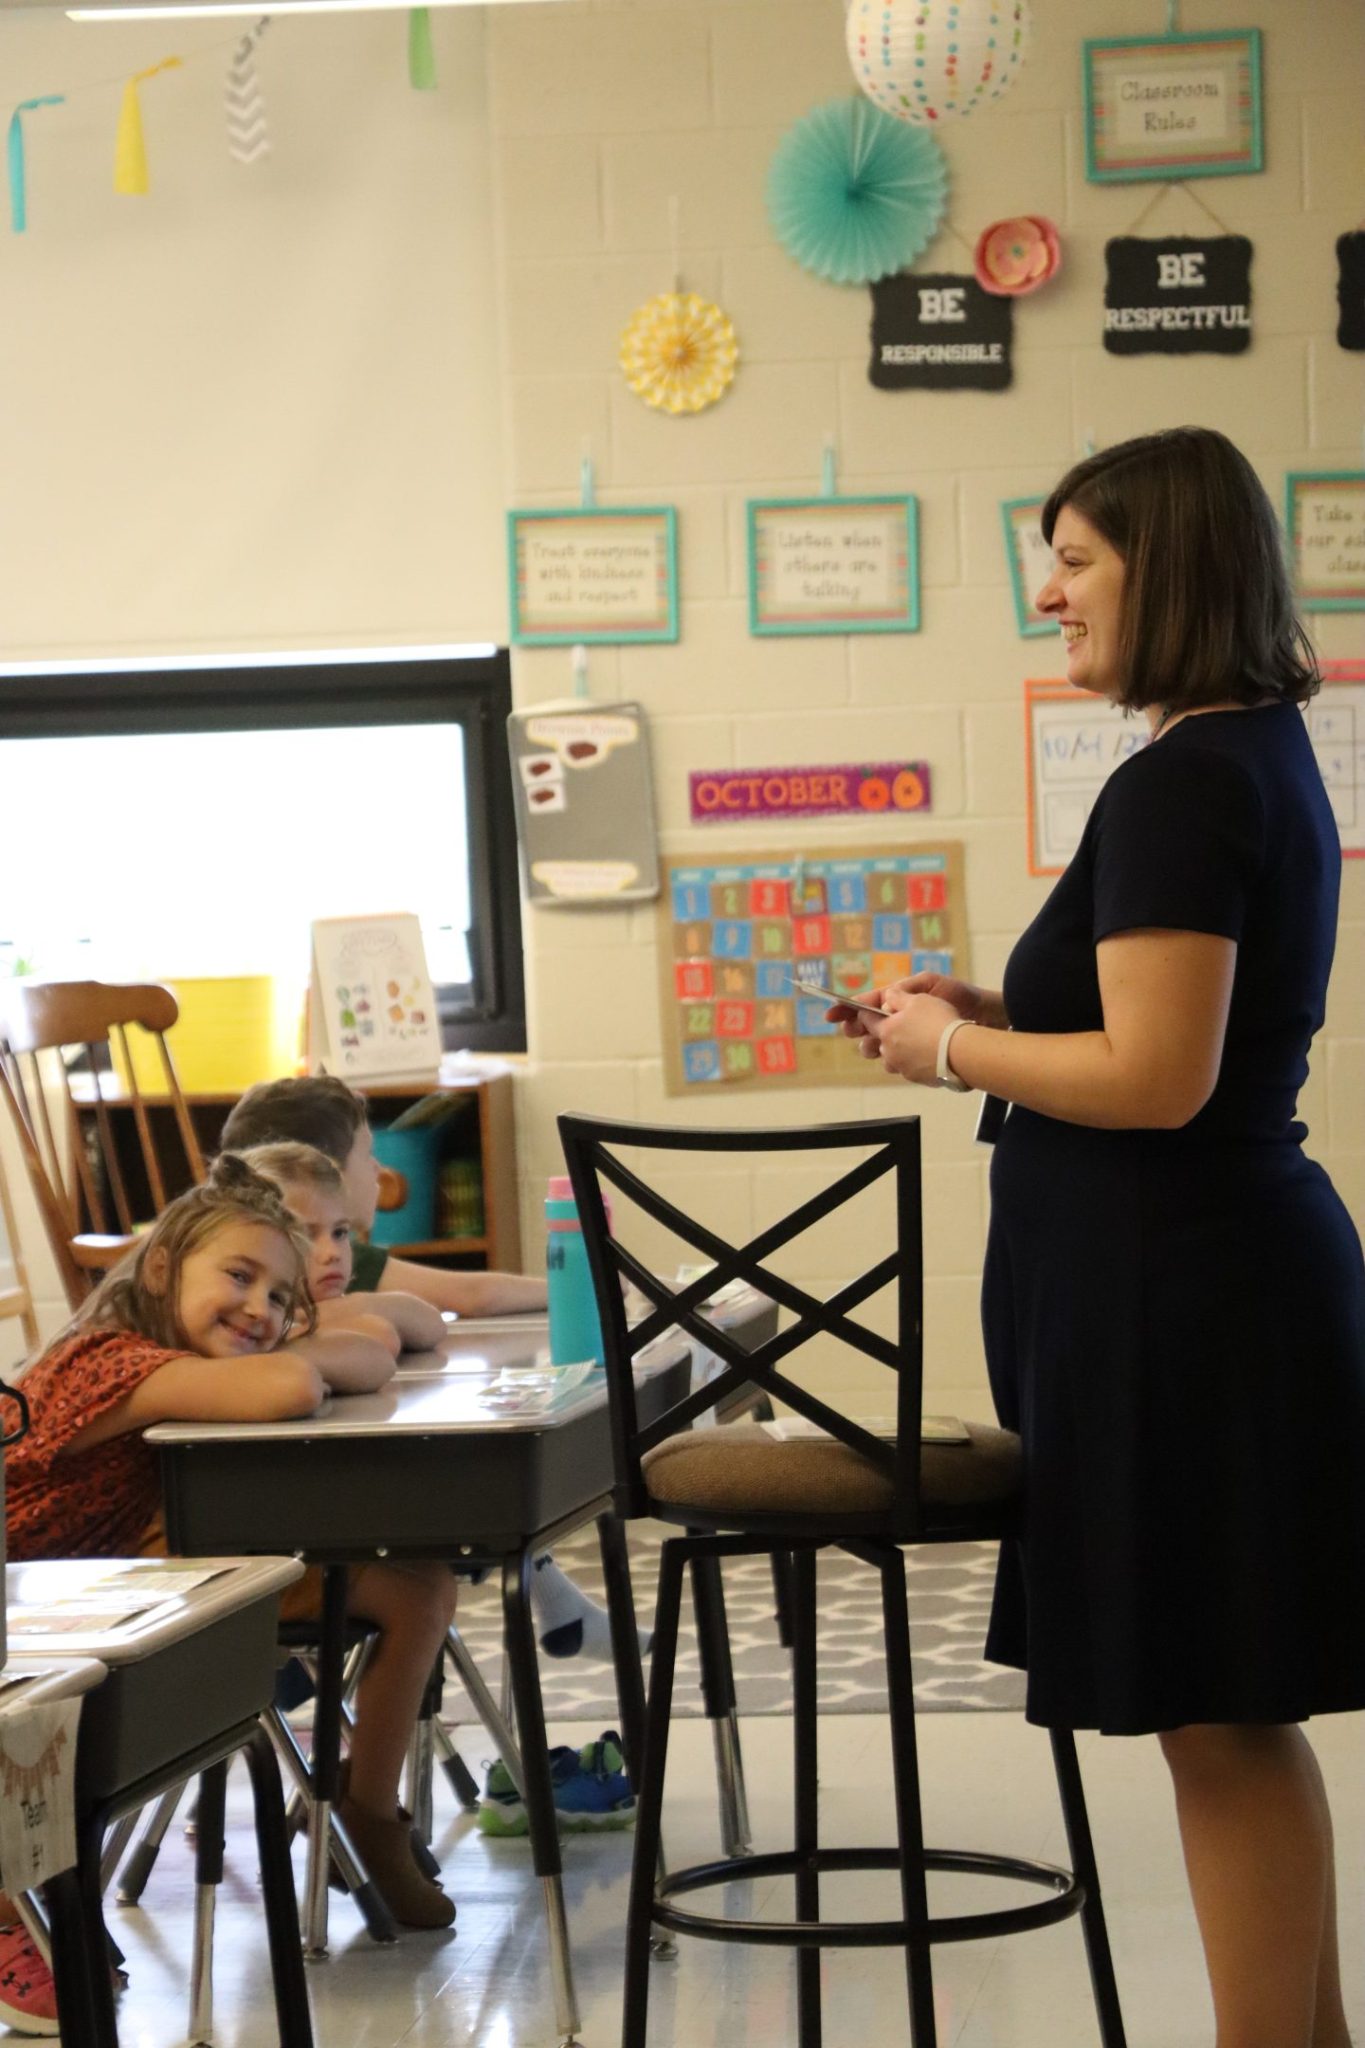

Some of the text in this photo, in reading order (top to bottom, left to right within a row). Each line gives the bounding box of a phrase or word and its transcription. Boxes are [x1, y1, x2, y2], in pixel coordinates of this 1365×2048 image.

[1120, 81, 1219, 101] Classroom
[1144, 111, 1197, 131] Rules
[1157, 252, 1206, 289] BE
[917, 288, 966, 323] BE
[1105, 305, 1252, 331] RESPECTFUL
[881, 343, 1004, 364] RESPONSIBLE
[696, 774, 849, 810] OCTOBER
[687, 1006, 711, 1034] 22
[20, 1799, 48, 1830] Team
